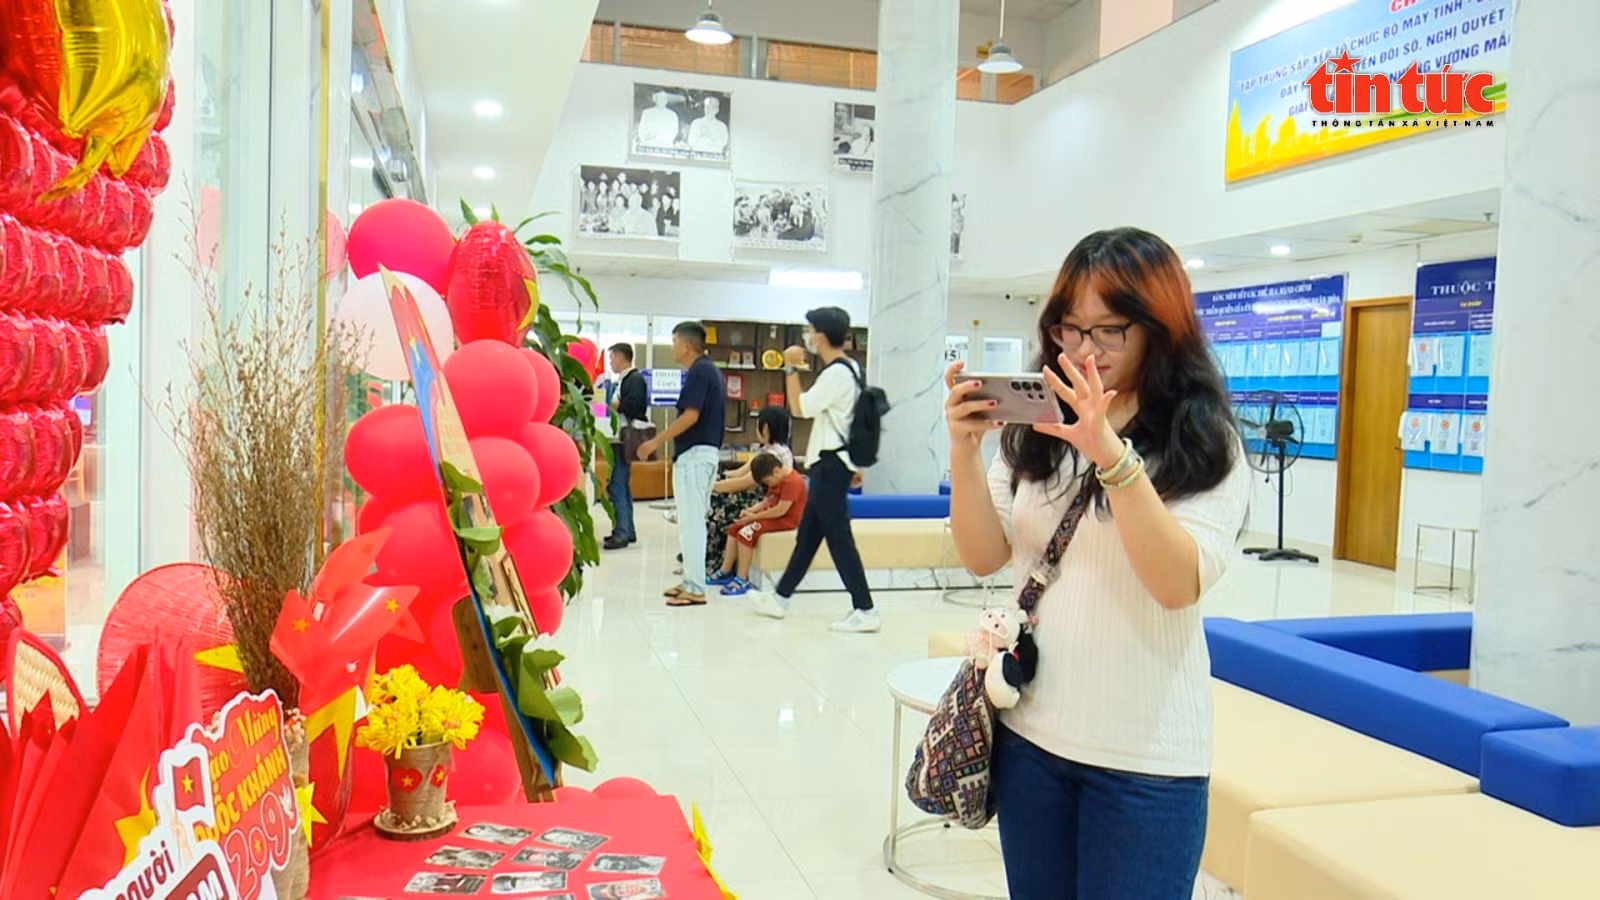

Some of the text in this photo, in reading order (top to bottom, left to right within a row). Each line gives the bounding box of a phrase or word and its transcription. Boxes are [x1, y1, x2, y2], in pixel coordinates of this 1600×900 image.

[1430, 280, 1481, 296] THUỘC
[237, 743, 288, 812] KHÁNH
[115, 840, 175, 900] ười
